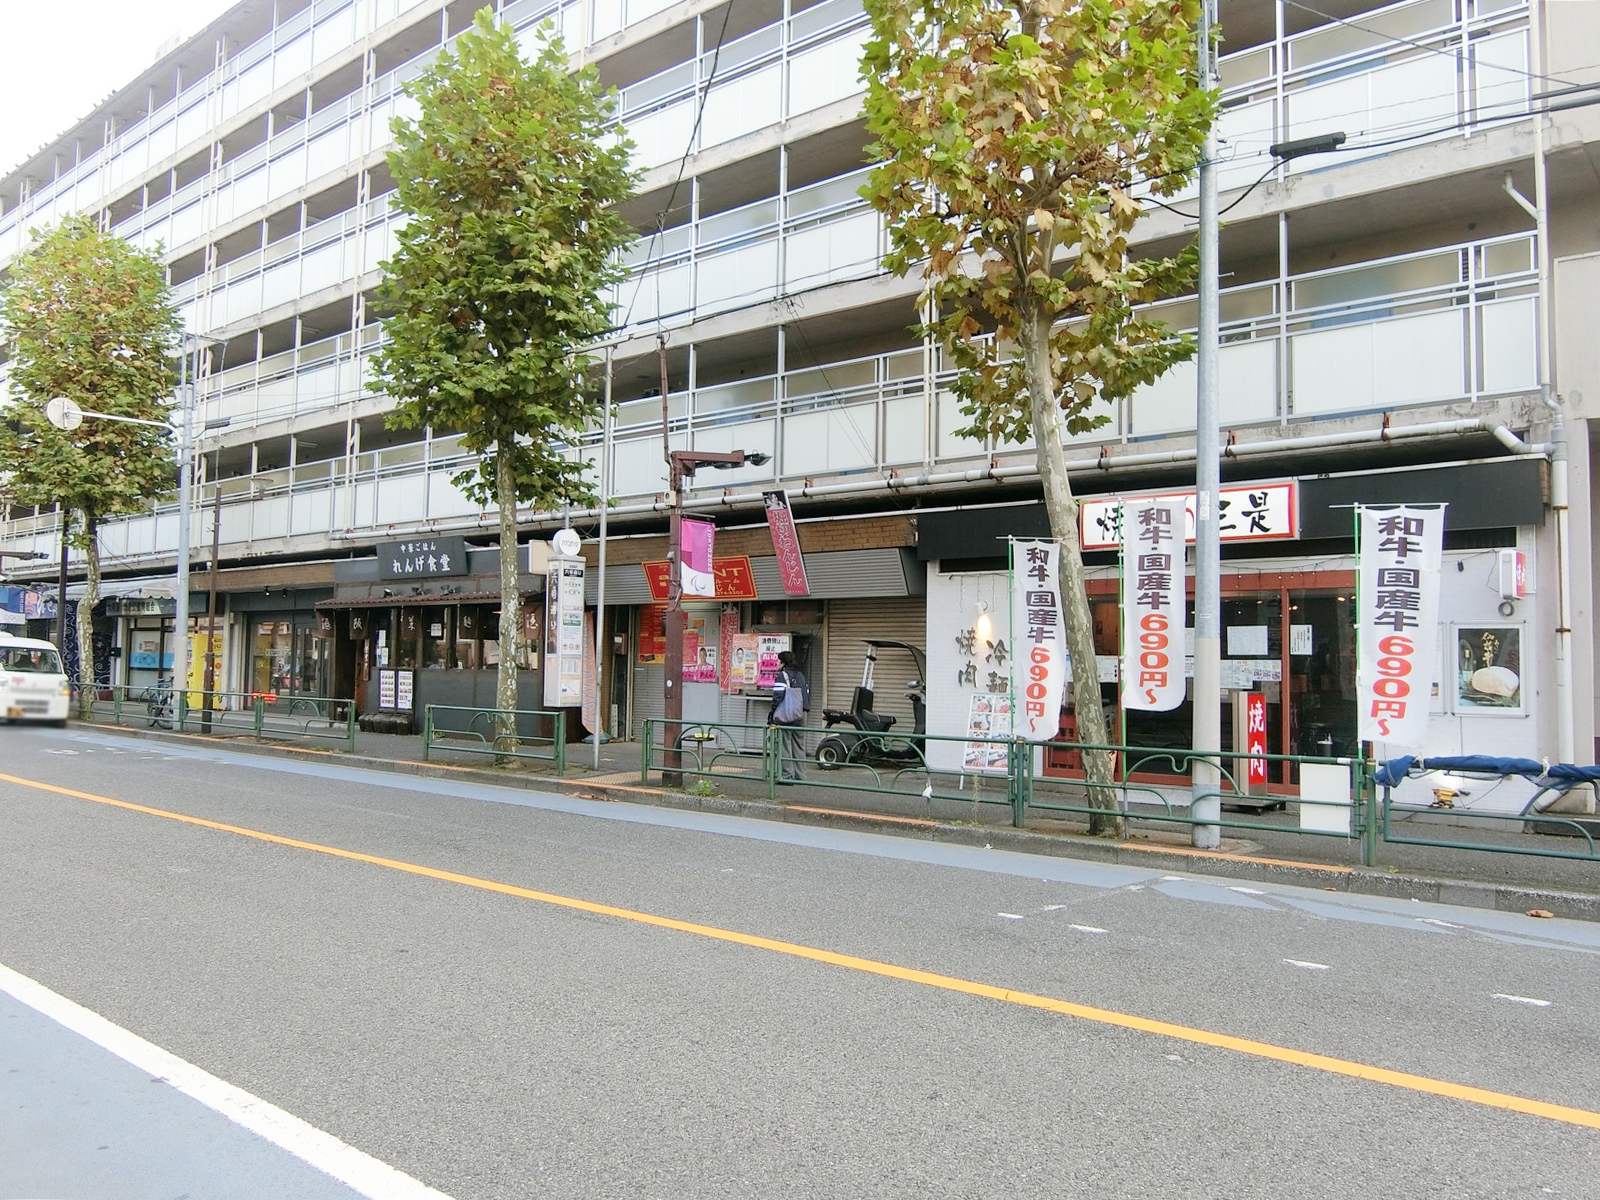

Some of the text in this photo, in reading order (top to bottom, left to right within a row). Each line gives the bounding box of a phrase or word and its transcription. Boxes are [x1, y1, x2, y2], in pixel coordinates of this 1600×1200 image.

[392, 553, 451, 574] れんげ食堂
[399, 541, 437, 554] 中華ごはん
[955, 627, 979, 689] 焼肉
[985, 638, 1010, 693] 冷麺
[1248, 700, 1265, 777] 焼肉
